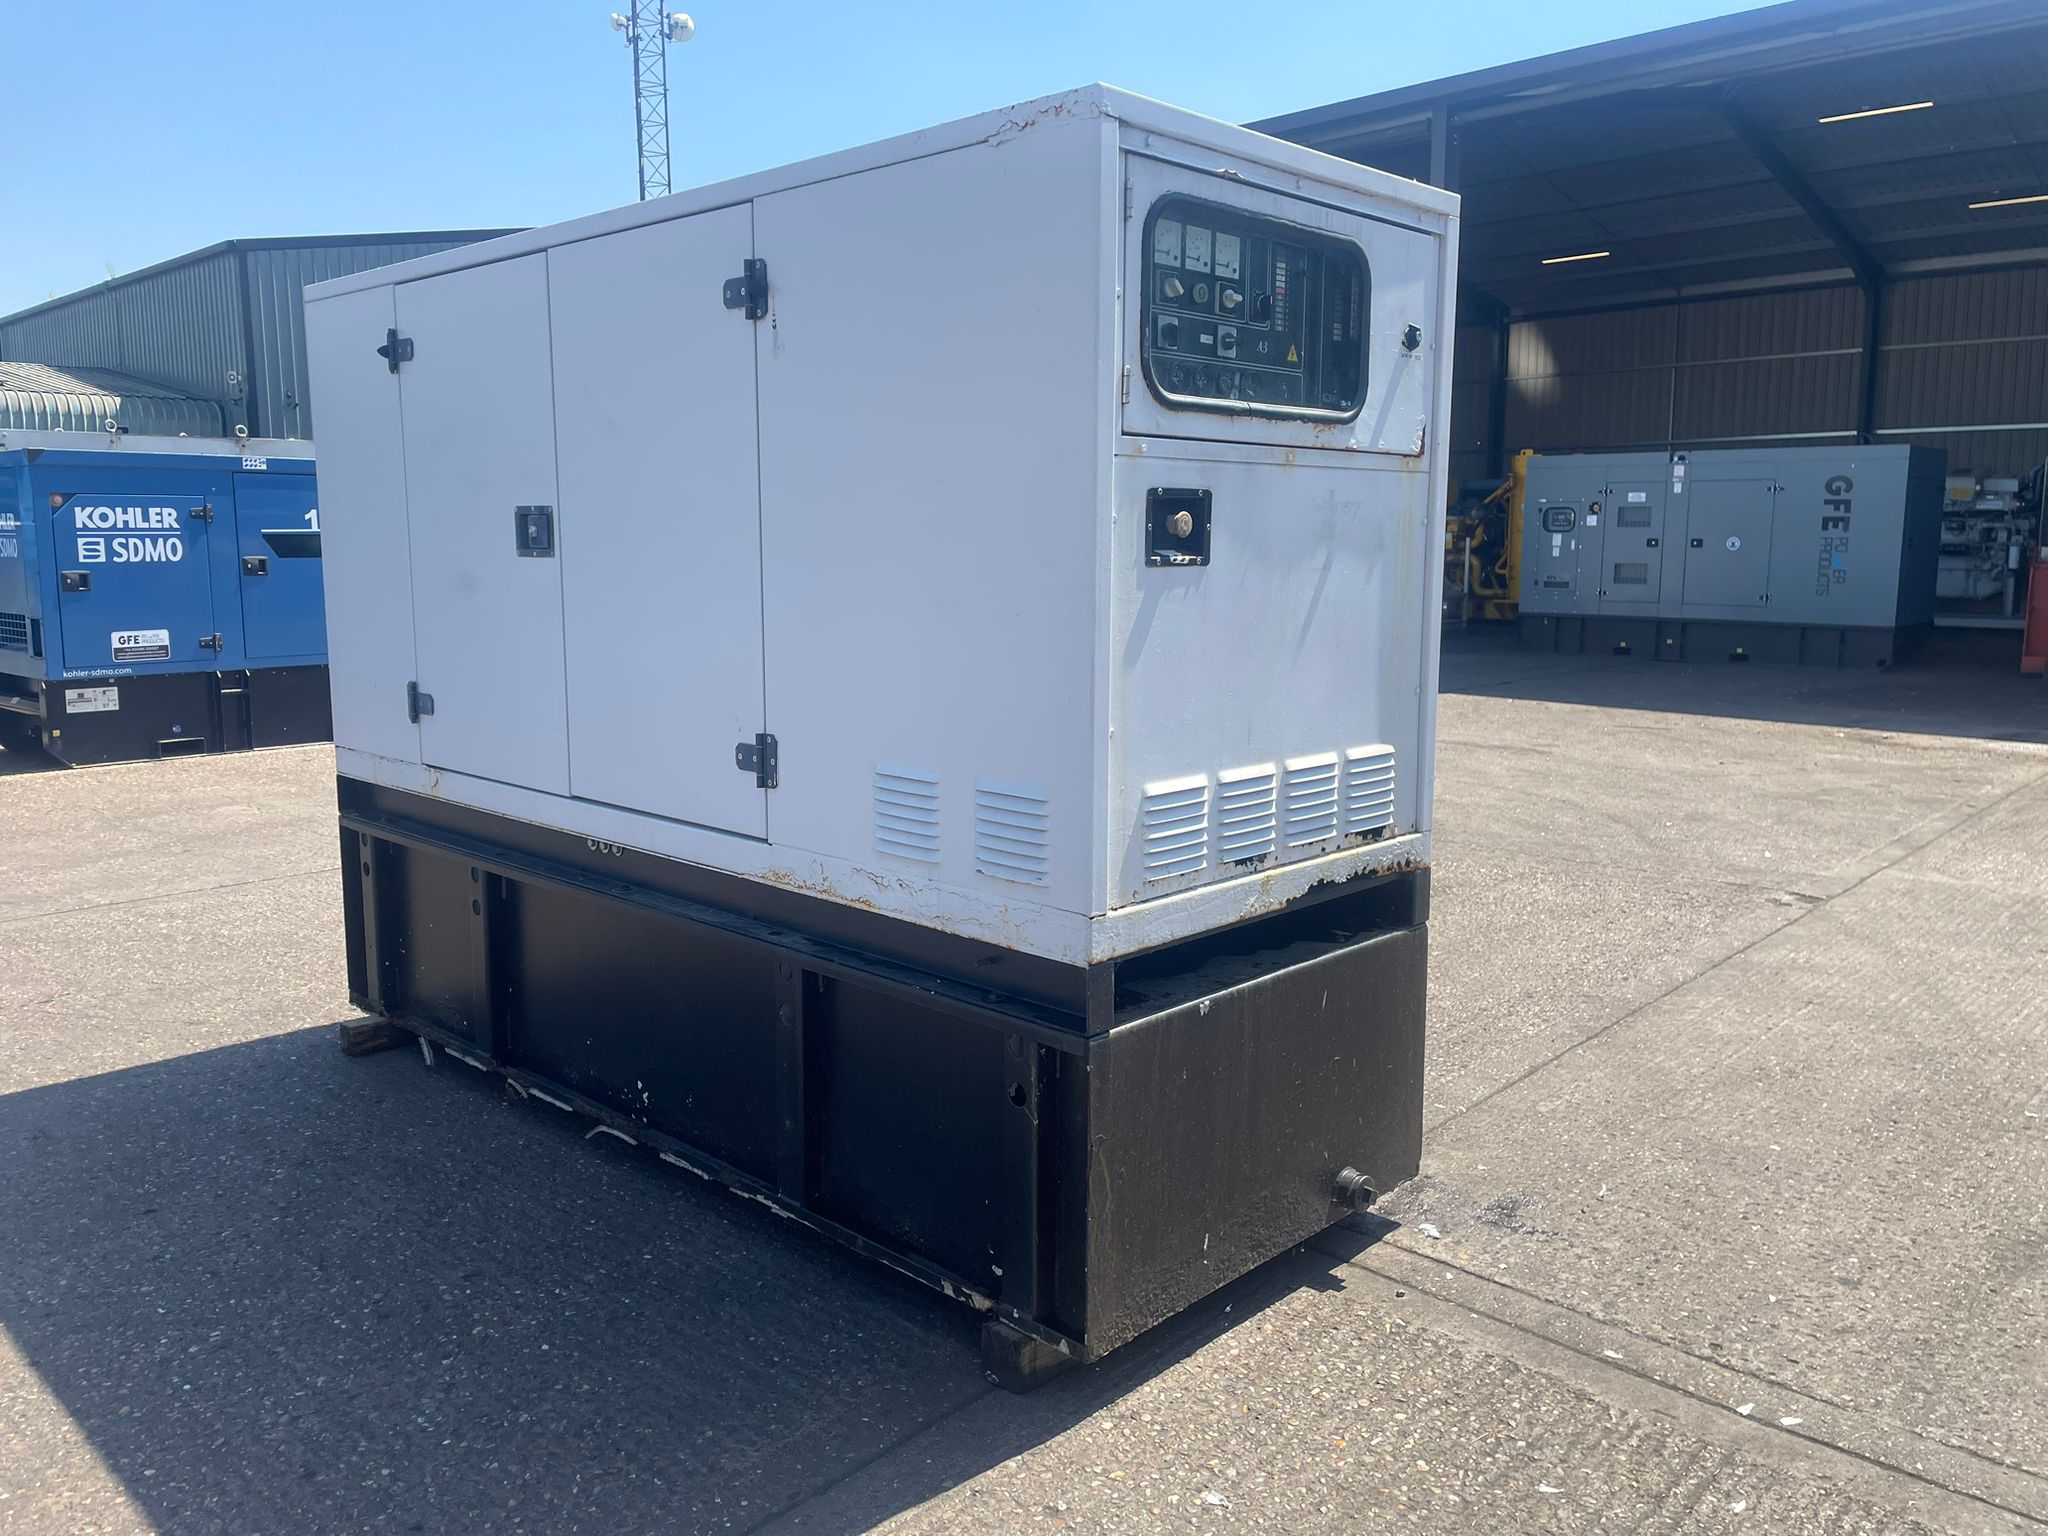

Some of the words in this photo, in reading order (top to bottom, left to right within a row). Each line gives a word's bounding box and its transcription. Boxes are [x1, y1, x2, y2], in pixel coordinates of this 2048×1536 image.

[1821, 475, 1854, 533] GFE
[74, 506, 180, 528] KOHLER
[112, 537, 183, 562] SDMO
[118, 635, 141, 645] GFE
[63, 668, 132, 678] kohler-sdmo.com
